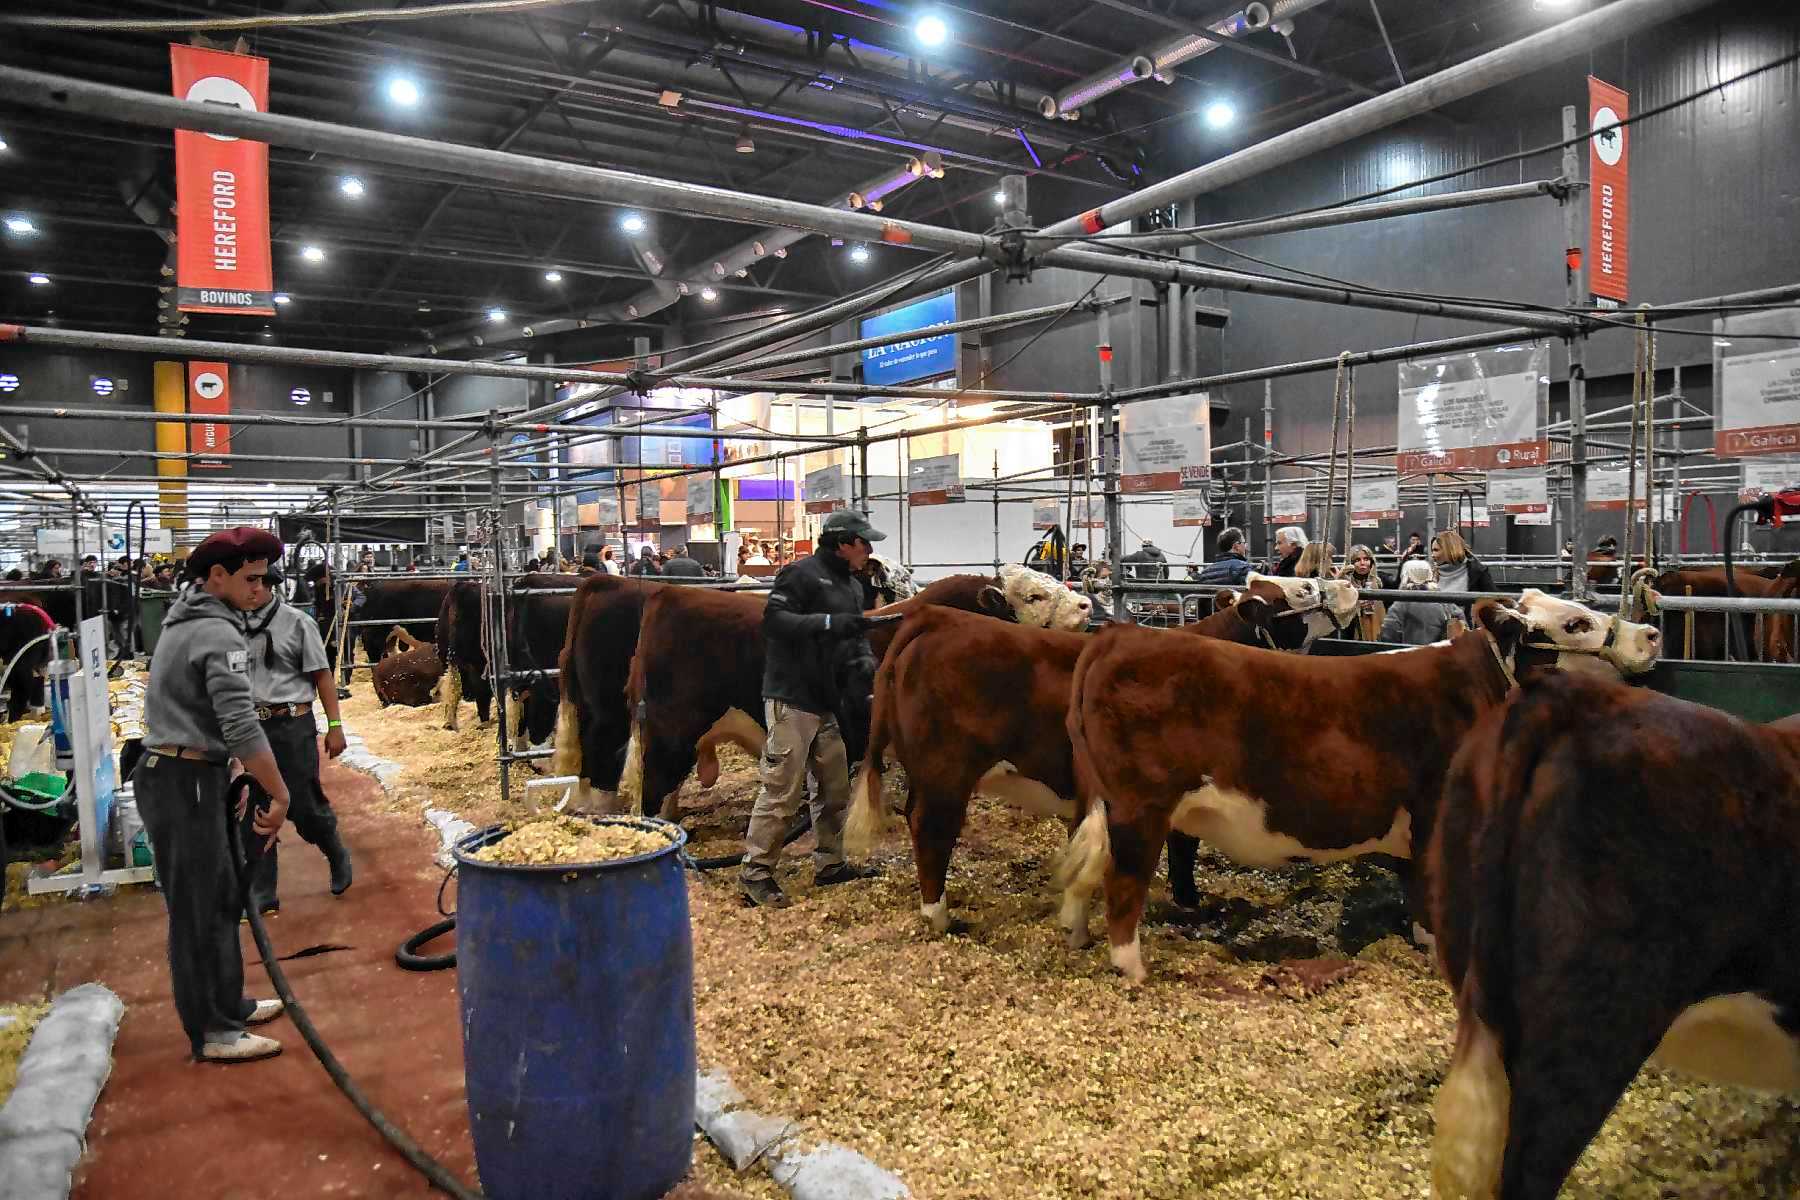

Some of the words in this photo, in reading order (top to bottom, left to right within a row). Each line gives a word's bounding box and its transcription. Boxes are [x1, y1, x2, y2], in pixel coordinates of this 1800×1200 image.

[213, 170, 237, 271] HEREFORD
[1602, 184, 1613, 274] HEREFORD
[200, 290, 253, 305] BOVINOS
[1751, 434, 1796, 448] Galicia
[1420, 454, 1452, 467] Galicia
[1513, 449, 1539, 460] Rural
